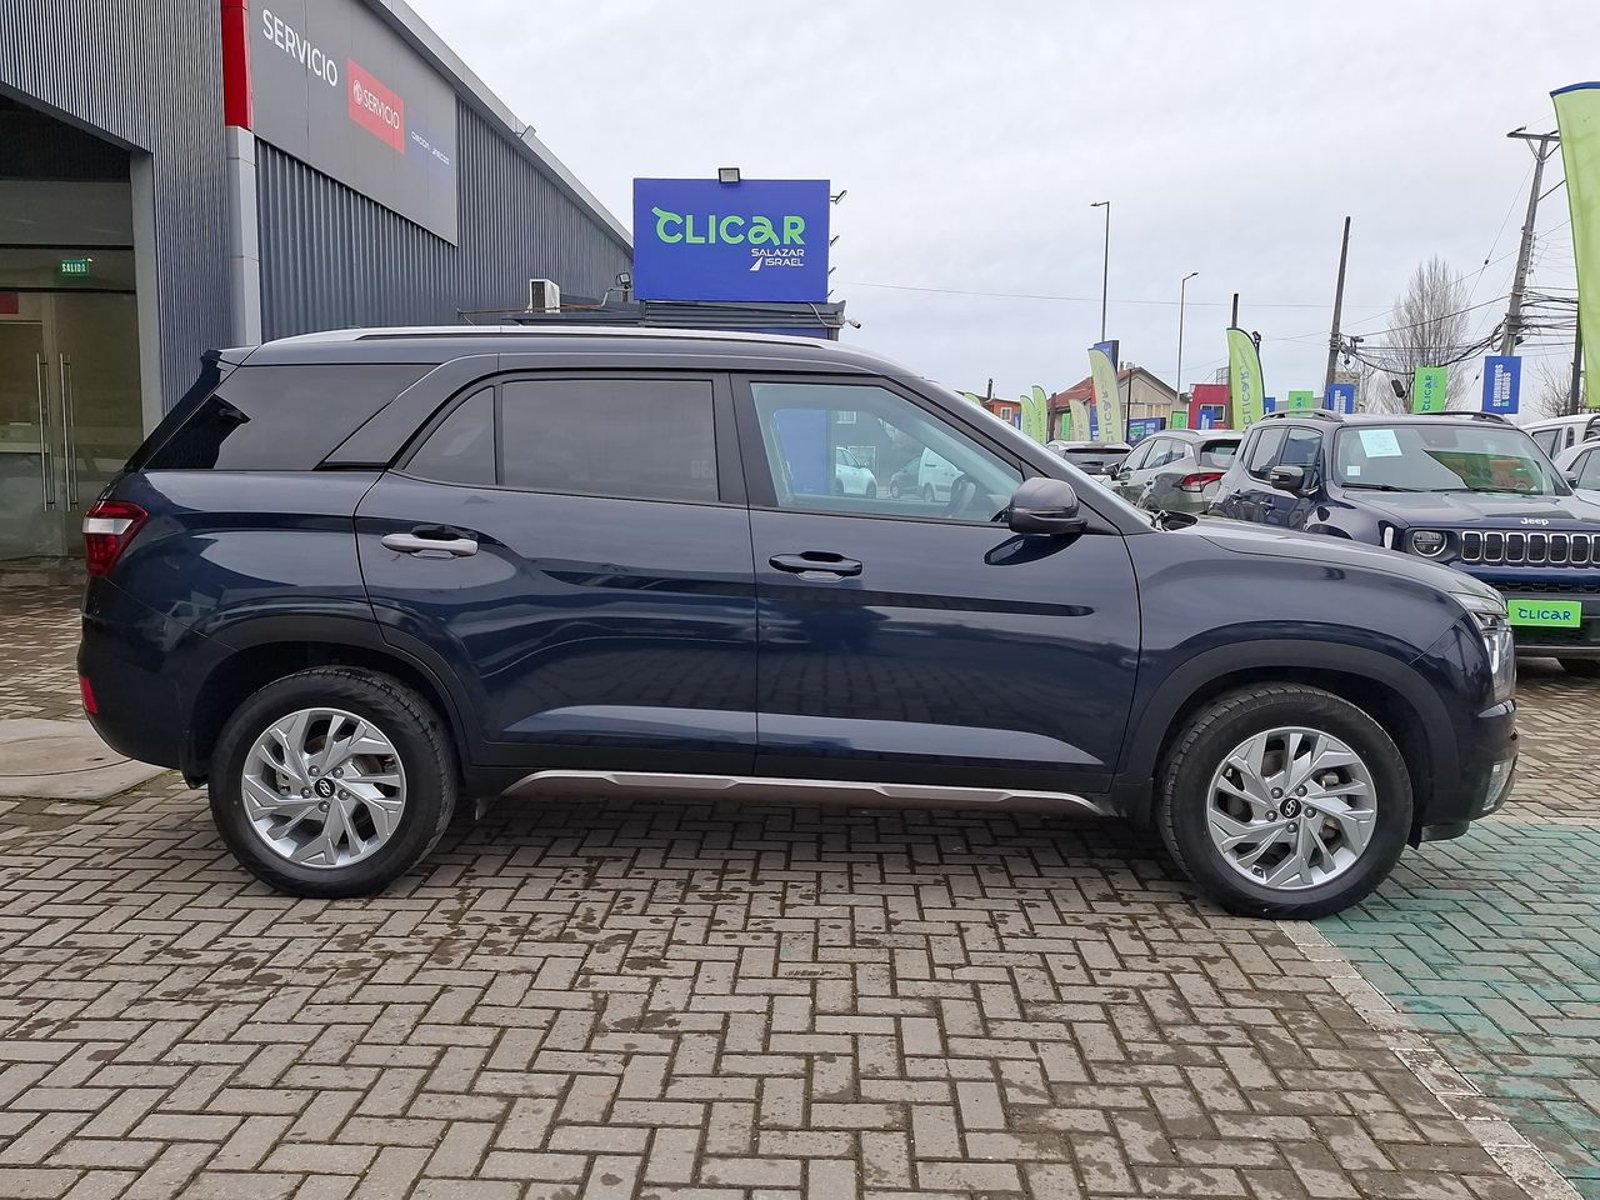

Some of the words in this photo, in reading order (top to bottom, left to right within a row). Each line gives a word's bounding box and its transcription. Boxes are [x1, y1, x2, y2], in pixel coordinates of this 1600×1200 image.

[262, 9, 338, 87] SERVICIO
[363, 89, 400, 130] SERVICIO
[750, 248, 805, 257] SALAZAR
[765, 258, 804, 267] ISRAEL
[62, 263, 86, 272] SALIDA
[1520, 518, 1549, 526] Jeep
